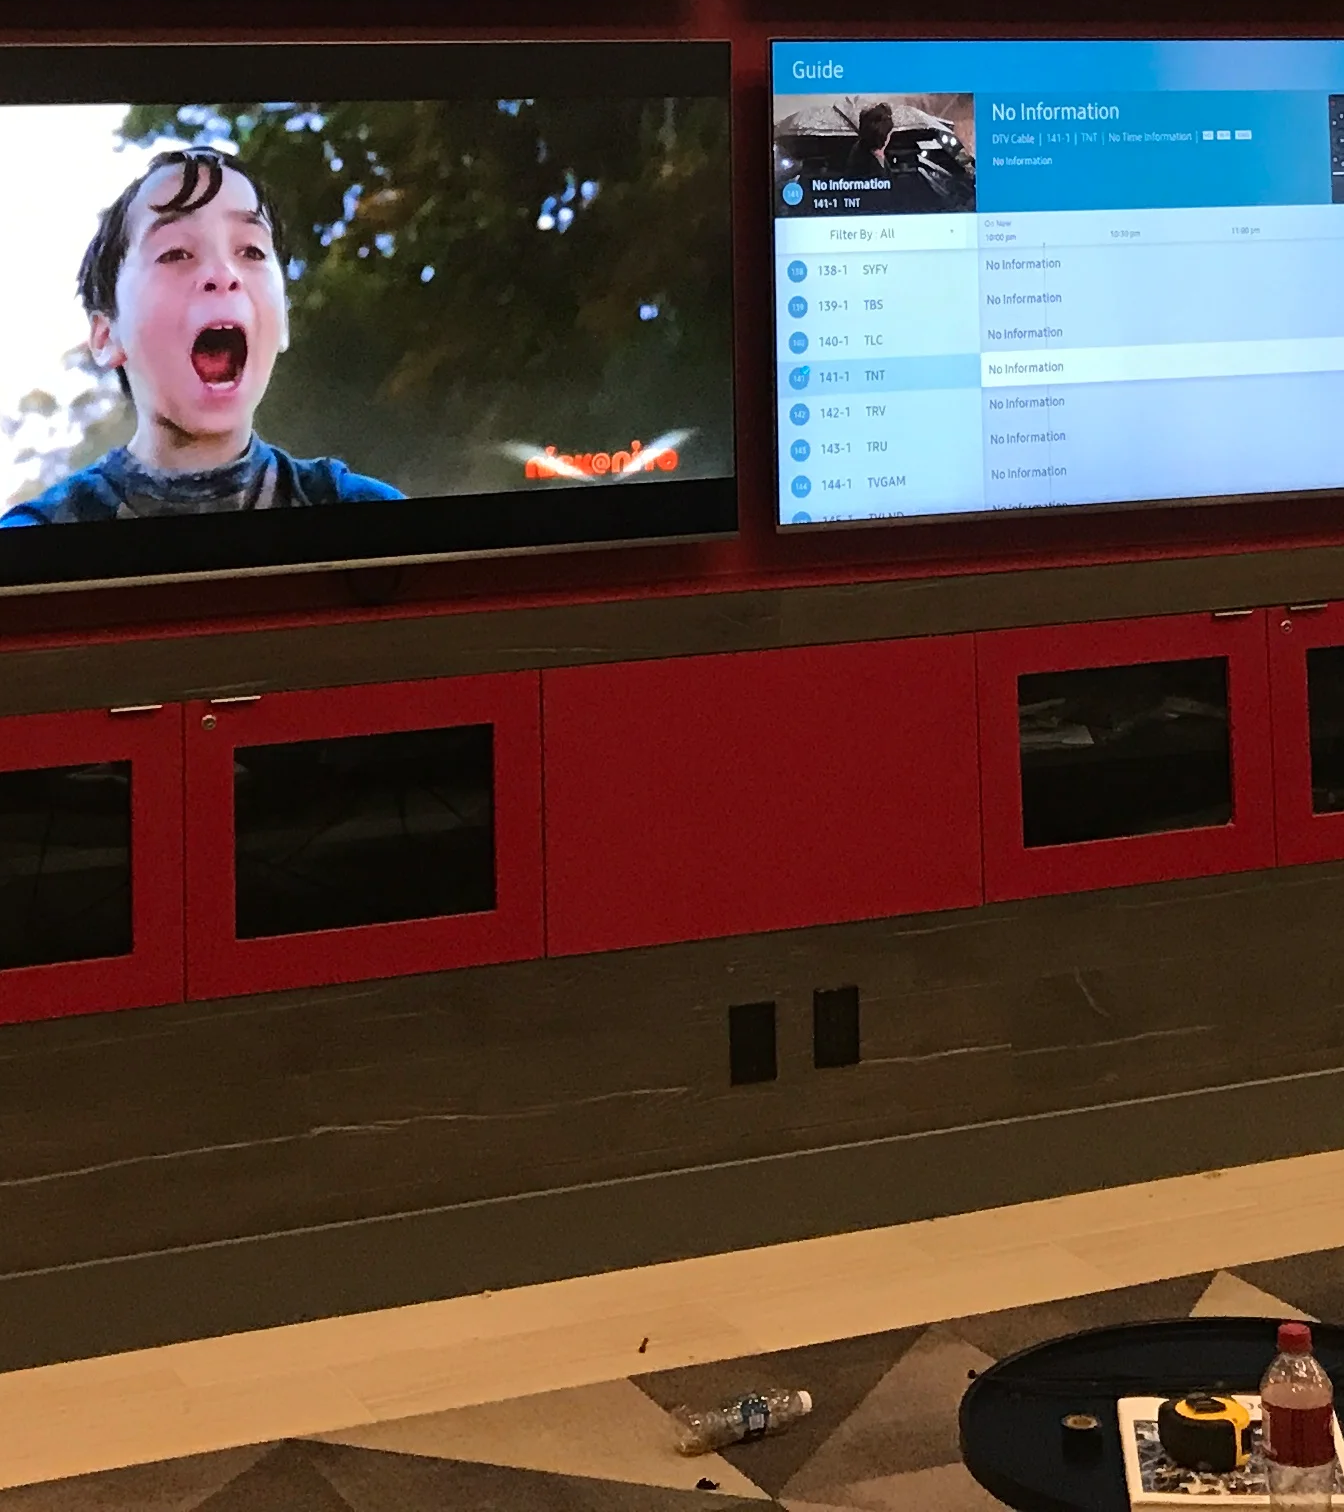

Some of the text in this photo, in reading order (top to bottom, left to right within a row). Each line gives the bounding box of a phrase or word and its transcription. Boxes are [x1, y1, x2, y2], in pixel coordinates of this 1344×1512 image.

[792, 60, 844, 80] Guide
[992, 101, 1120, 121] No Information
[992, 133, 1010, 144] DTV
[1011, 133, 1035, 144] Cable
[1081, 132, 1098, 142] TNT
[1109, 132, 1121, 142] No
[1123, 132, 1143, 142] Time
[1144, 131, 1192, 142] Information
[992, 155, 1053, 166] No Information
[812, 178, 891, 191] No Information
[814, 197, 860, 208] 141-1 TNT
[829, 229, 858, 241] Filter
[859, 229, 873, 242] By
[880, 227, 895, 239] All
[818, 263, 888, 276] 138-1 SYFY
[986, 258, 1061, 271] No Information
[818, 299, 884, 311] 139-1 TBS
[987, 292, 1062, 305] No Information
[987, 326, 1063, 340] No Information
[818, 334, 884, 347] 140-1 TLC
[988, 362, 1064, 375] No Information
[819, 370, 885, 383] 141-1 TNT
[989, 396, 1065, 410] No Information
[820, 406, 886, 419] 142-1 TRV
[991, 431, 1066, 445] No Information
[821, 441, 887, 454] 143-1 TRU
[991, 466, 1067, 480] No Information
[821, 476, 906, 491] 144-1 TVGAM
